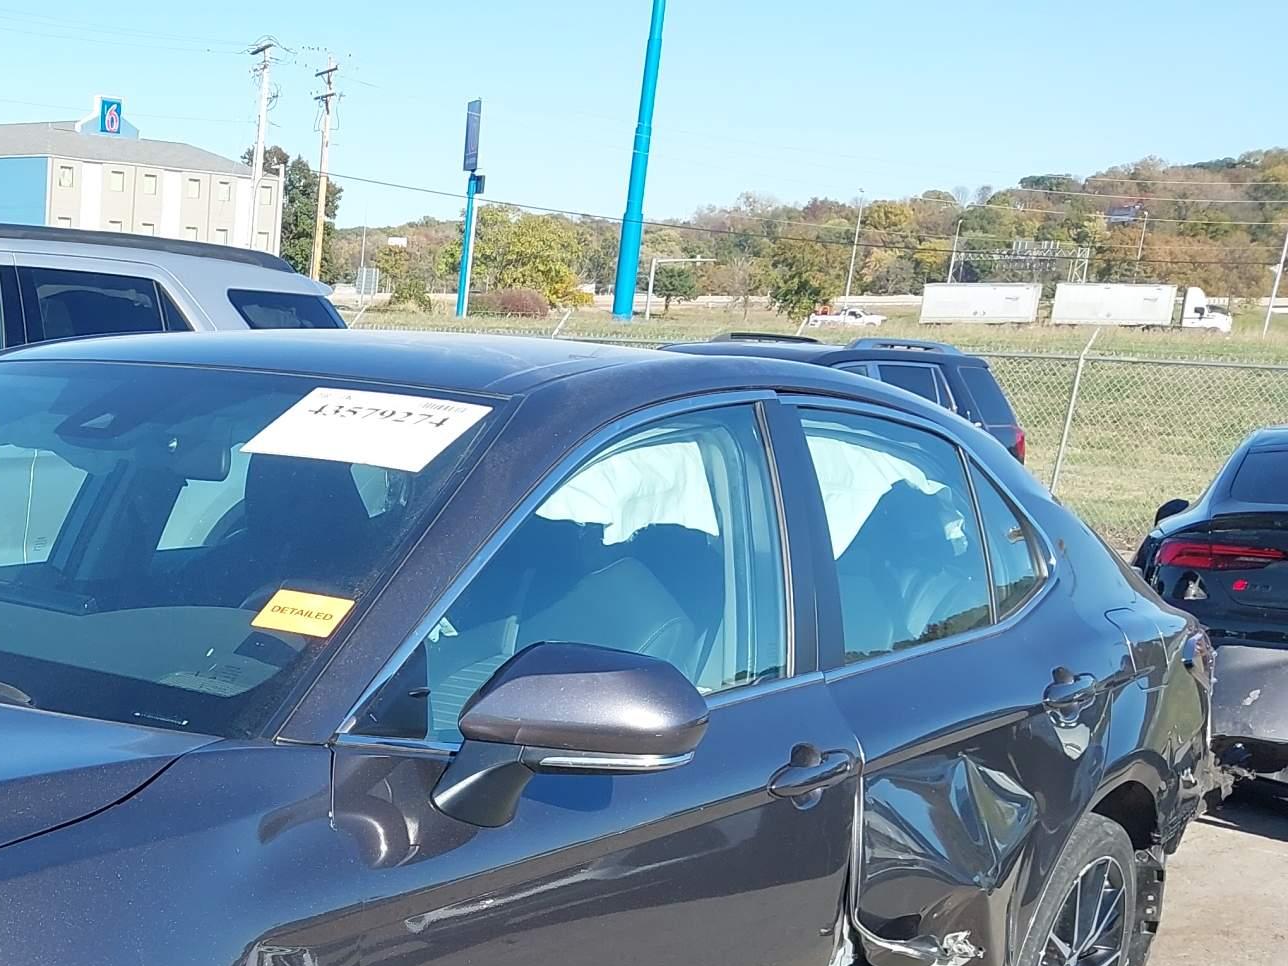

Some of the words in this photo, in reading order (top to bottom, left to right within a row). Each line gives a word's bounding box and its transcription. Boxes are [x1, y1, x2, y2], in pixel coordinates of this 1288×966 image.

[105, 103, 120, 132] 6
[308, 403, 450, 428] 43579274
[271, 605, 334, 621] DETAILED
